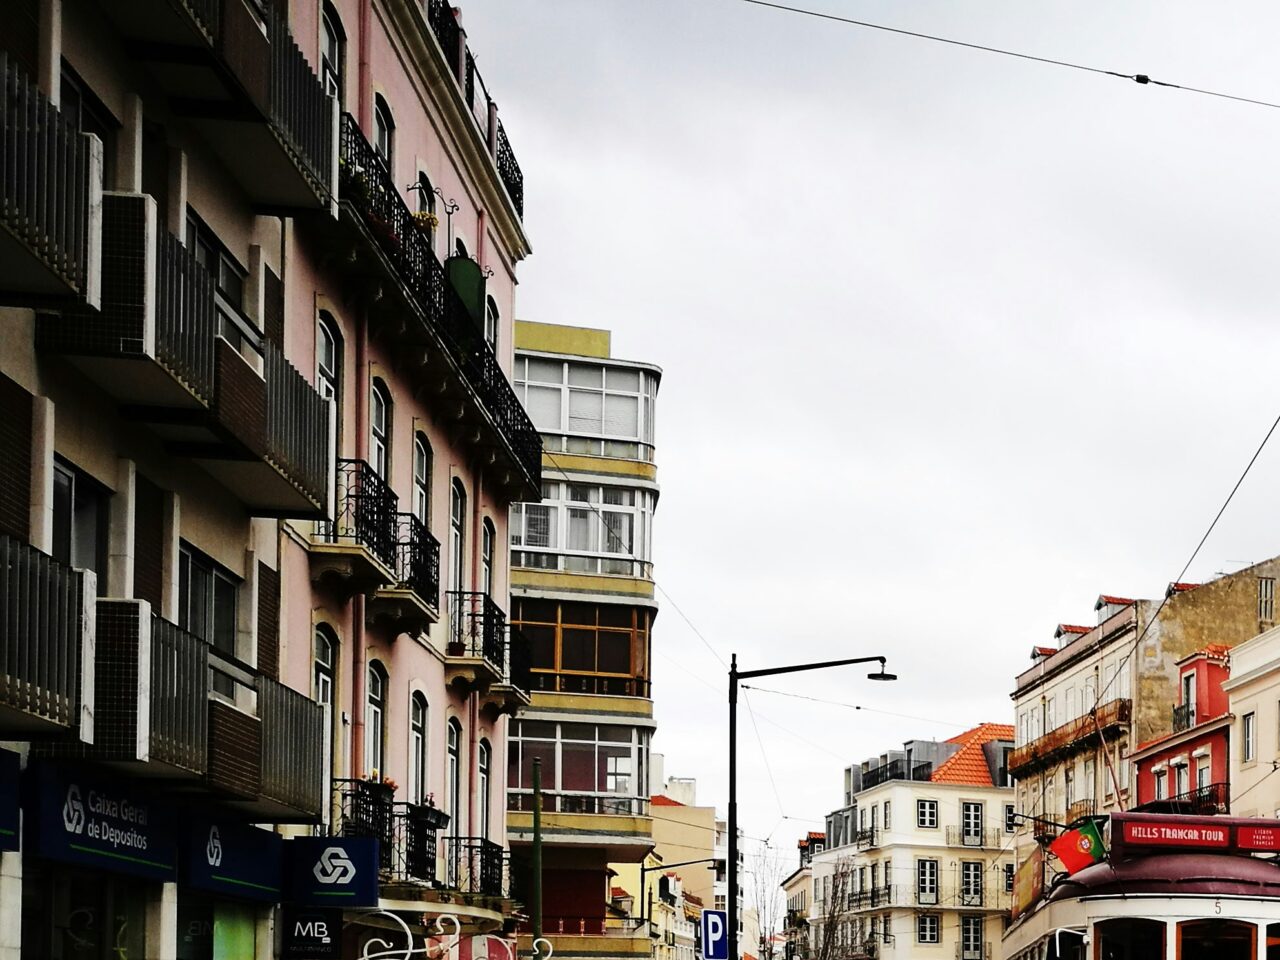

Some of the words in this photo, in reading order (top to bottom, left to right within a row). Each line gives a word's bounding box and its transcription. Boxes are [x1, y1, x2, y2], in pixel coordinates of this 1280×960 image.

[88, 790, 119, 818] Caixa
[120, 799, 148, 826] Geral
[87, 818, 100, 839] de
[1131, 826, 1159, 838] HILLS
[1160, 828, 1200, 840] TRAMCAR
[1201, 830, 1225, 842] TOUR
[1215, 901, 1221, 914] 5
[294, 921, 329, 938] MB
[707, 914, 723, 956] P
